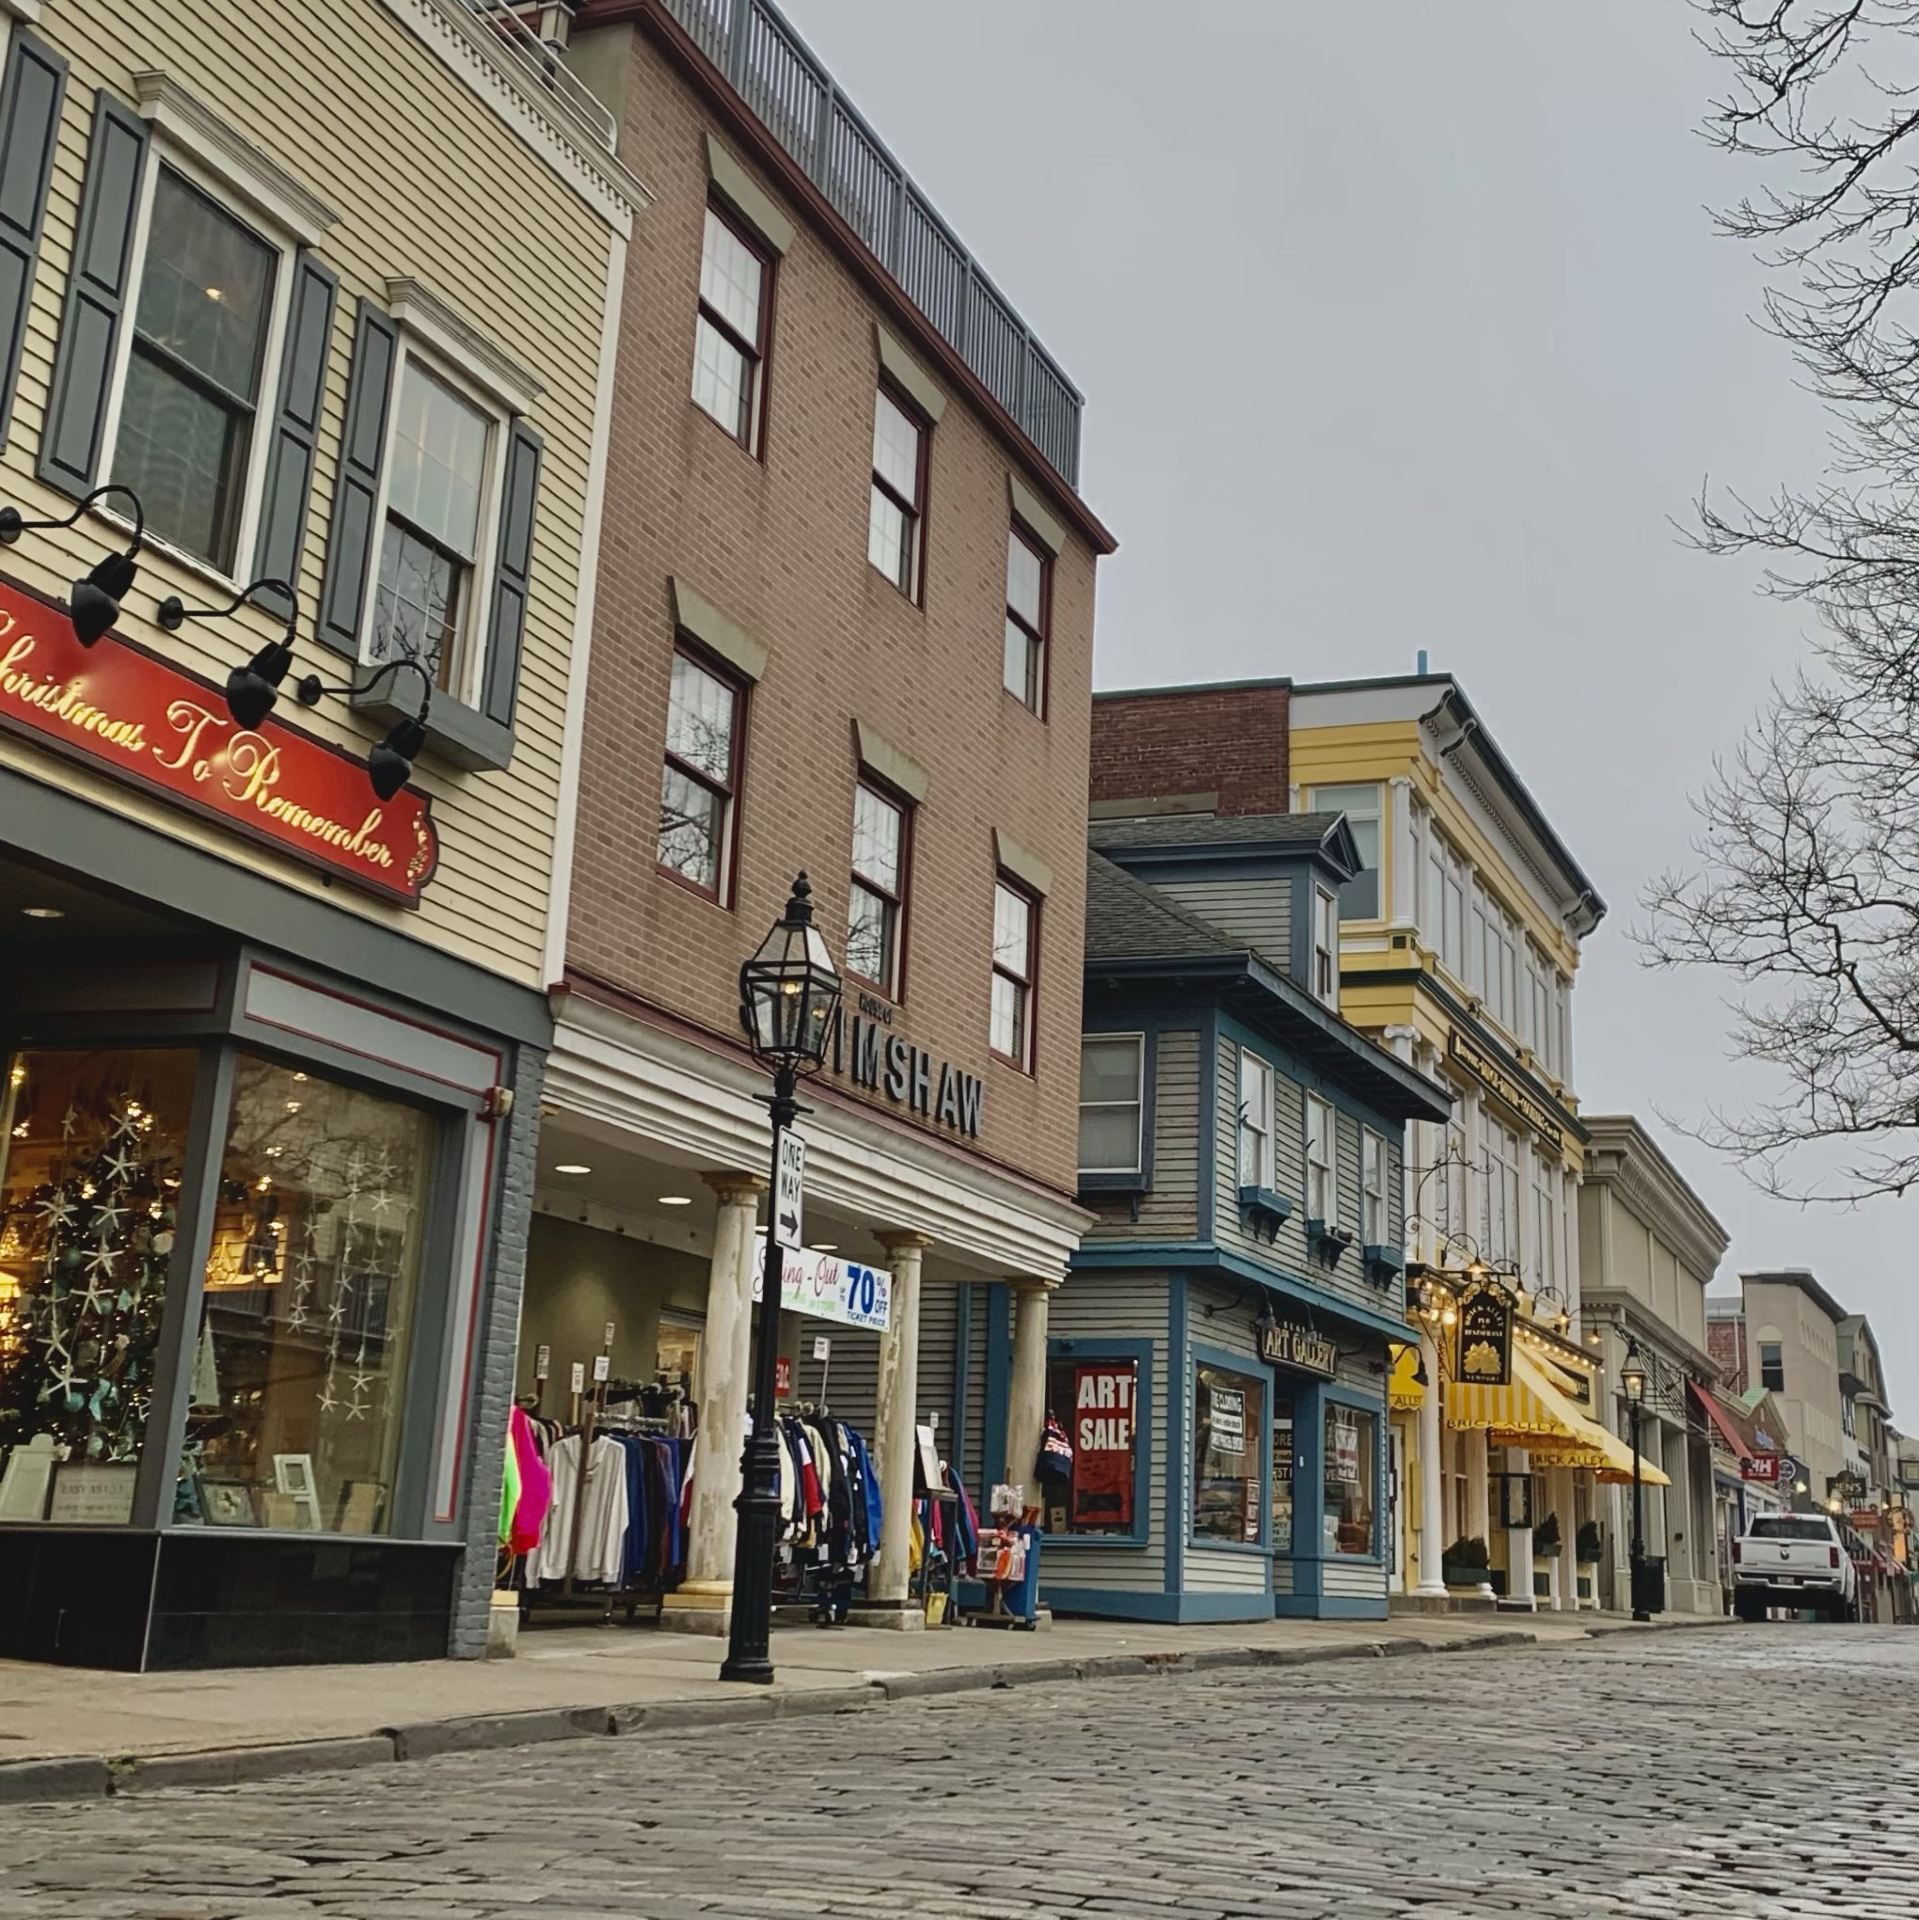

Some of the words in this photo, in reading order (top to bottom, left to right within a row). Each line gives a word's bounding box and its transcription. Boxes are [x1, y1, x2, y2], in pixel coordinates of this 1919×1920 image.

[152, 700, 228, 782] To
[223, 730, 394, 868] Remember
[833, 1005, 984, 1139] IMSHAW
[782, 1139, 801, 1172] ONE
[781, 1171, 800, 1203] WAY
[847, 1310, 868, 1323] TICKET
[875, 1299, 888, 1316] OFF
[1266, 1329, 1290, 1359] ART
[1293, 1332, 1336, 1374] GALLERY
[1077, 1375, 1133, 1409] ART
[1394, 1396, 1420, 1407] ALLE
[1079, 1417, 1130, 1451] SALE
[1274, 1434, 1292, 1447] ORE
[1528, 1453, 1563, 1466] BRICK
[1567, 1454, 1606, 1466] ALLEY
